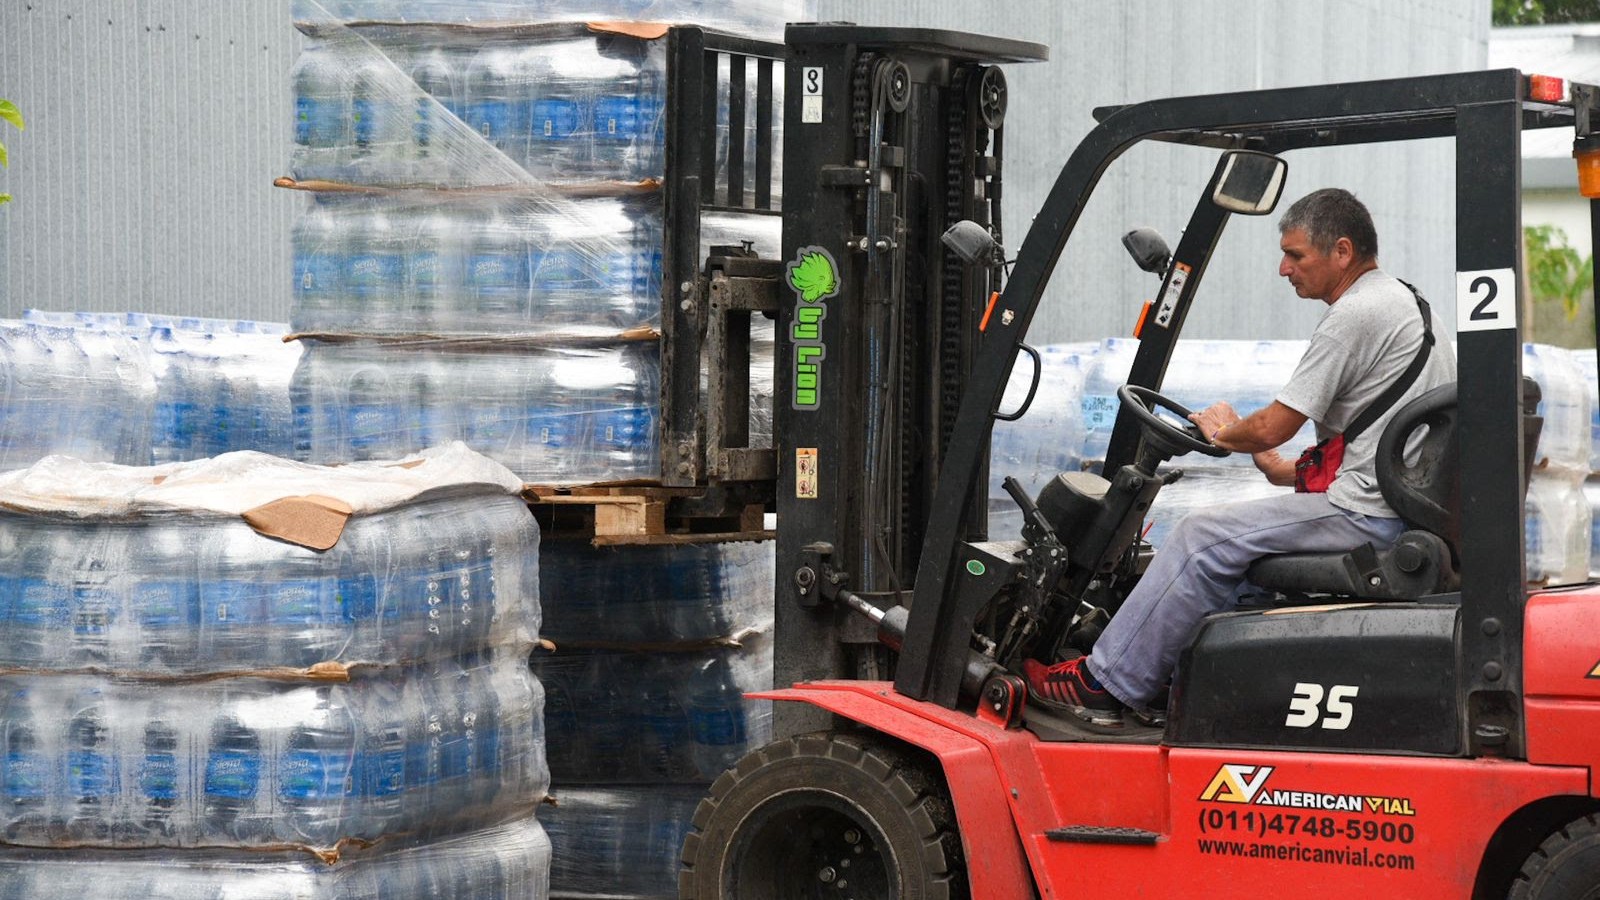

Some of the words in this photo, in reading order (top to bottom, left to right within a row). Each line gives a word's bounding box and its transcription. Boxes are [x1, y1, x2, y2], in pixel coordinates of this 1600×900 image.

[1469, 276, 1498, 321] 2
[793, 307, 823, 339] by
[796, 346, 822, 405] Lion
[1254, 788, 1363, 812] AMERICAN
[1364, 796, 1416, 816] VIAL
[1199, 808, 1414, 844] (011)4748-5900
[1198, 839, 1415, 870] www.americanvial.com
